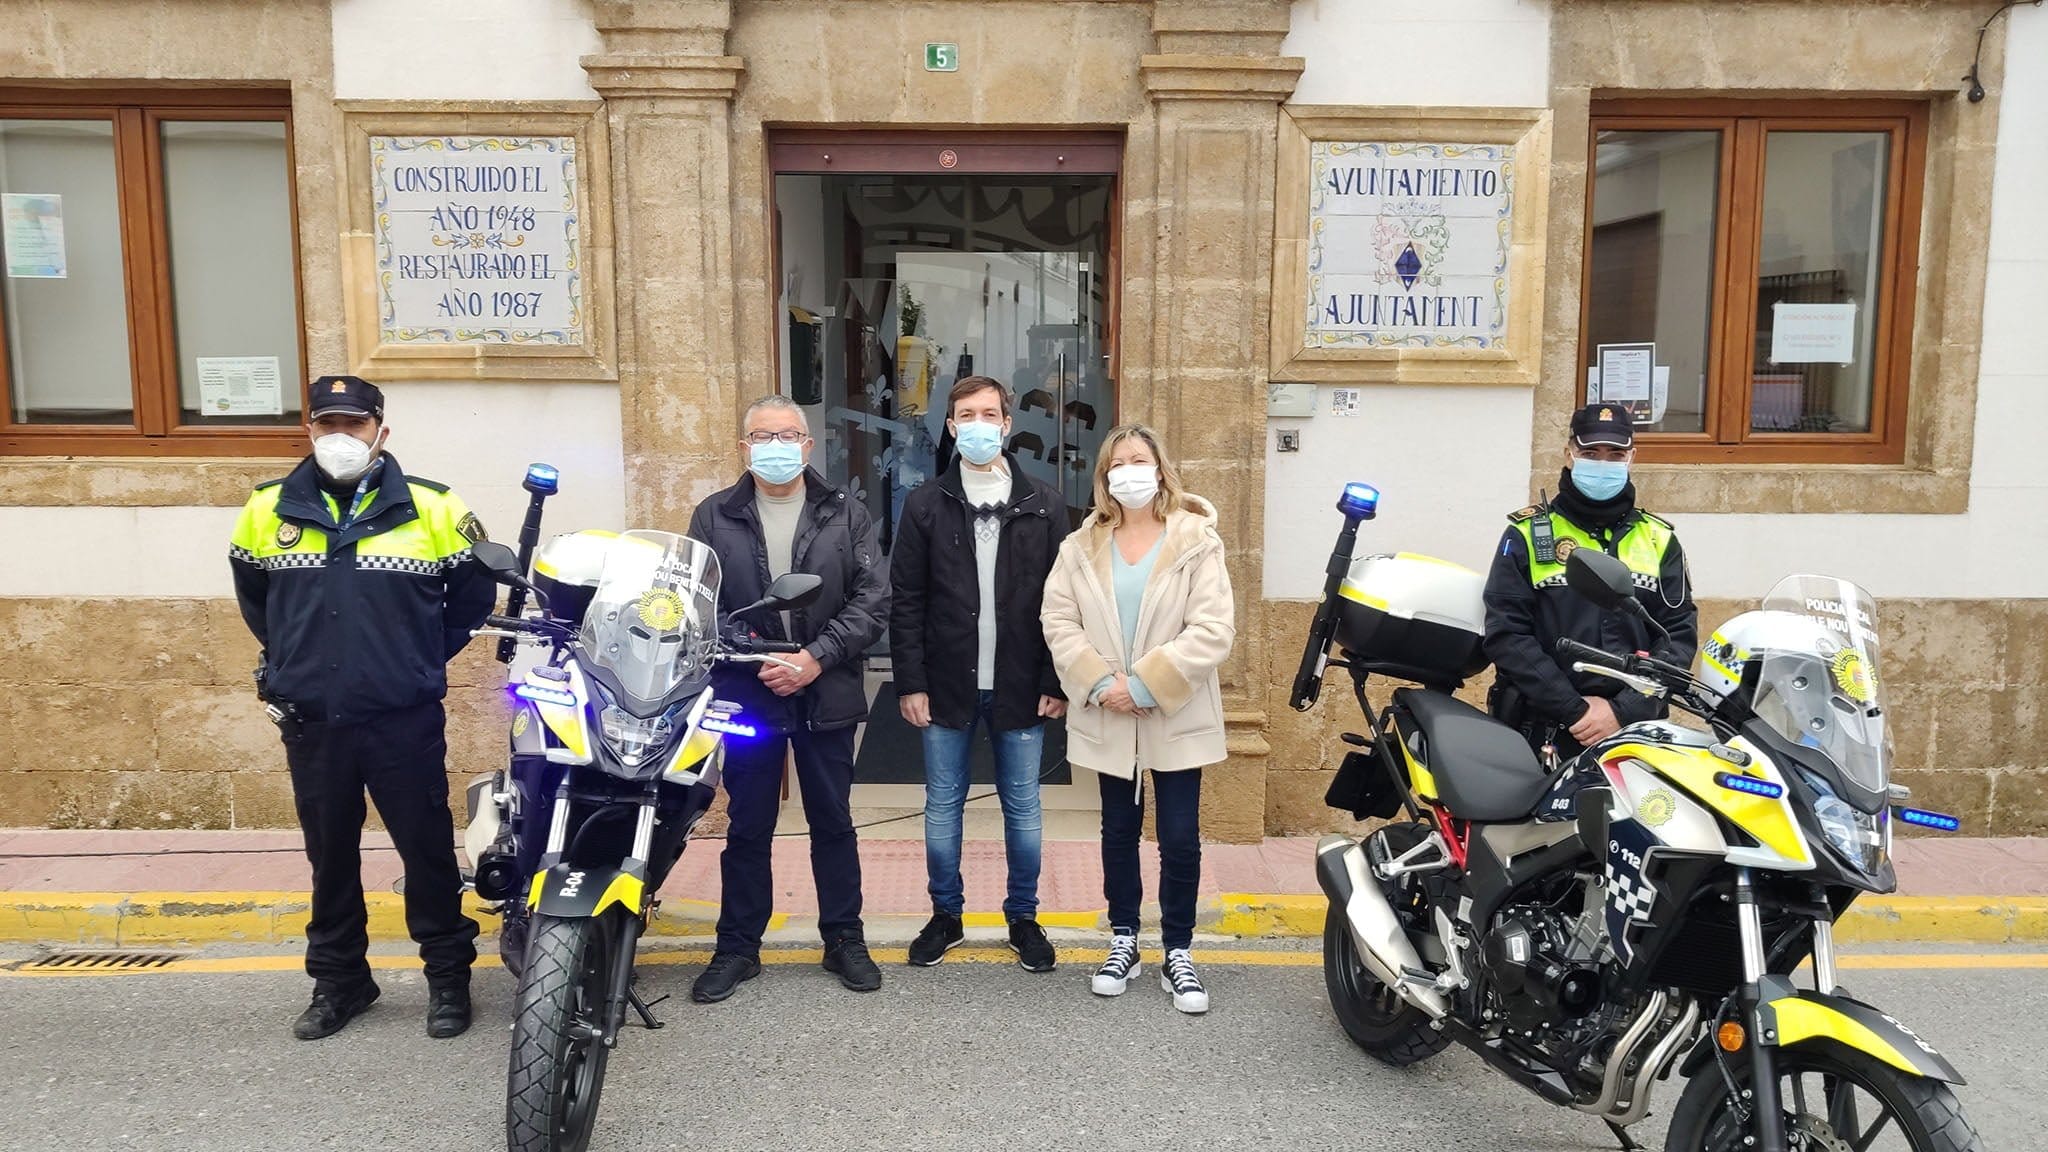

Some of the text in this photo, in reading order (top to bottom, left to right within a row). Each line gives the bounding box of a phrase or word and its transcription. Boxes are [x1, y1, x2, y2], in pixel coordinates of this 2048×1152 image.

[936, 47, 947, 67] 5
[394, 166, 548, 193] CONSTRUIDO EL
[1327, 167, 1496, 197] AYUNTAMIENTO
[429, 201, 536, 231] AÑO 1948
[400, 253, 556, 280] RESTAURADO EL
[437, 287, 543, 318] AÑO 1987
[1325, 294, 1483, 327] AJUNTAMENT
[1826, 618, 1848, 633] NOU
[1620, 848, 1641, 870] 112
[559, 871, 586, 897] R-04
